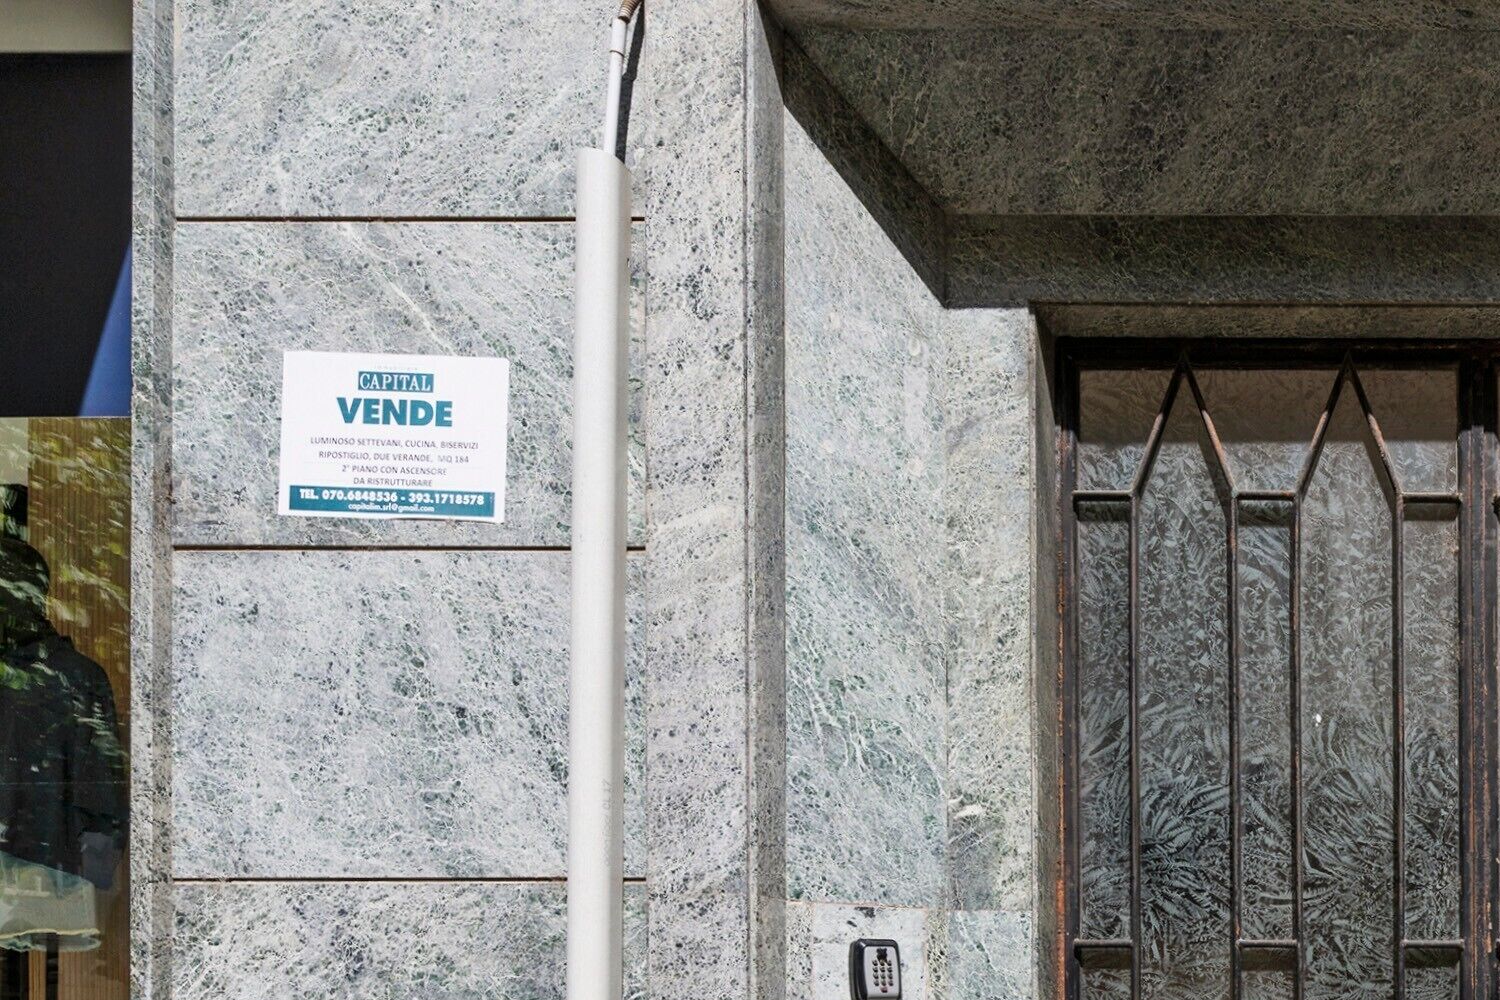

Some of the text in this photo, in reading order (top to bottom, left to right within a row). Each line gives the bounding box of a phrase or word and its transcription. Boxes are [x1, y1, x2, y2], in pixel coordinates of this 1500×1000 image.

[359, 372, 432, 392] CAPITAL
[336, 397, 453, 427] VENDE
[310, 437, 355, 446] LUMINOSO
[440, 441, 479, 450] BISERVIZI
[319, 451, 372, 461] RIPOSTIGLIO,
[373, 453, 390, 461] DUE
[352, 465, 378, 473] PIANO
[380, 466, 398, 474] CON
[400, 467, 448, 476] ASCENSORE
[353, 477, 433, 487] DA RISTRUTTURARE
[299, 488, 319, 500] TEL.
[408, 492, 485, 506] 393.1718578
